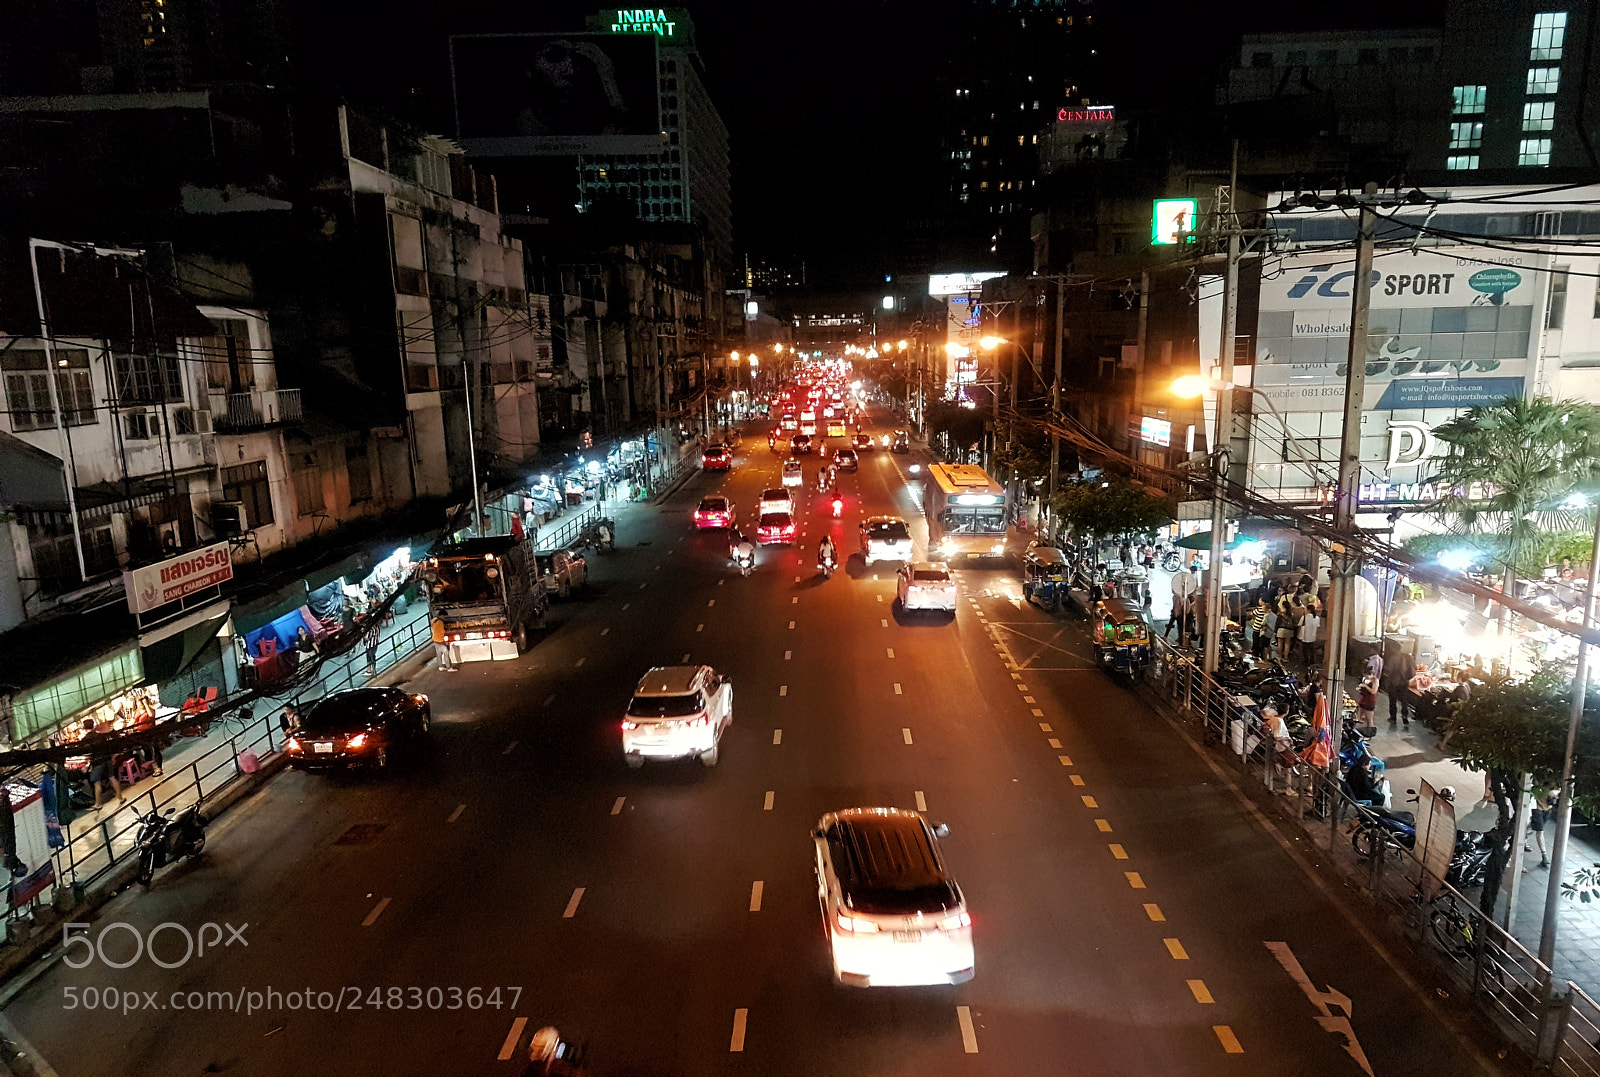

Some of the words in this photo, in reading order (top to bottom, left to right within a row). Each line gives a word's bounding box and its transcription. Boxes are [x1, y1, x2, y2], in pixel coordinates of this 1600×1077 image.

[617, 9, 667, 23] INDRA
[1058, 108, 1113, 120] CENTARA
[1384, 273, 1455, 296] SPORT
[1295, 323, 1351, 334] Wholesale
[1301, 388, 1318, 397] 081
[160, 547, 229, 583] แสงเจริญ
[164, 588, 183, 601] SANG
